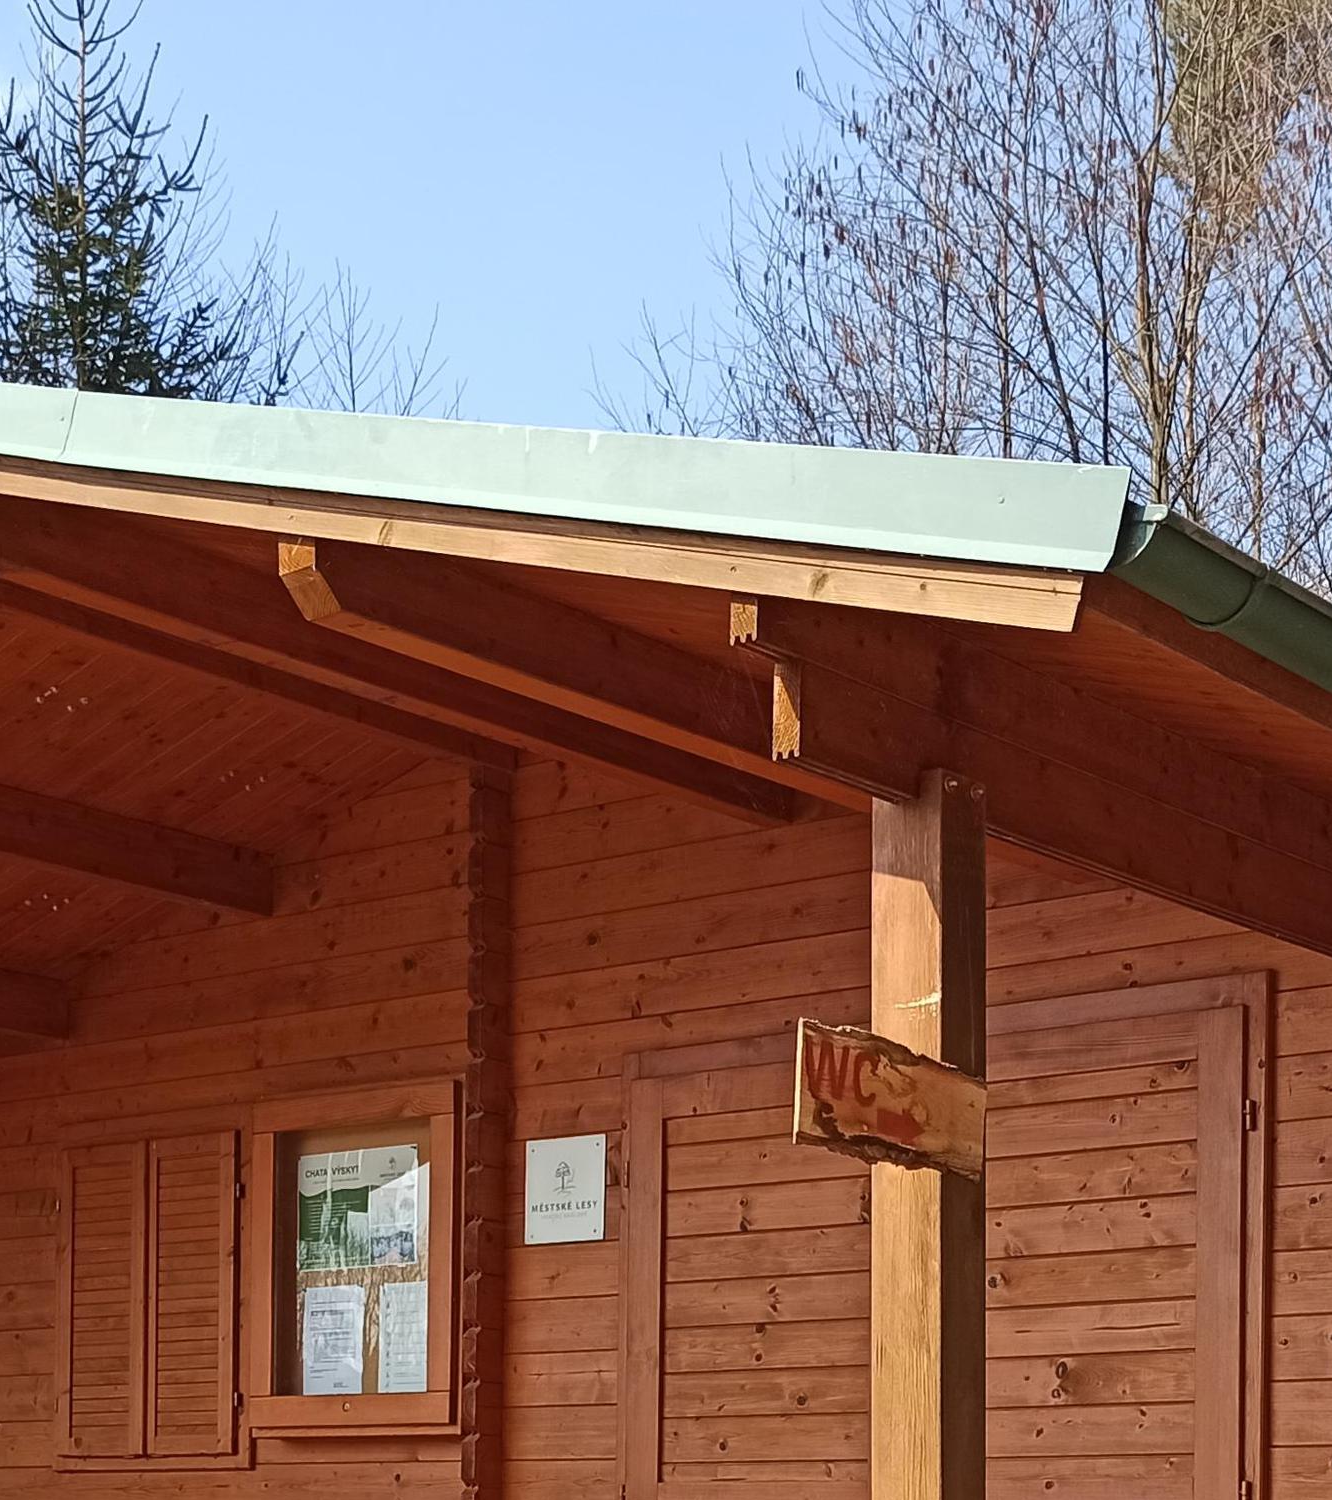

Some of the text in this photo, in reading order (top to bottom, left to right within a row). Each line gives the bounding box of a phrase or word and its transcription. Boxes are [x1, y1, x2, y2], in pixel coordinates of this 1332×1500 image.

[805, 1034, 881, 1107] WC
[305, 1168, 327, 1178] CHATA
[575, 1199, 597, 1210] LESY
